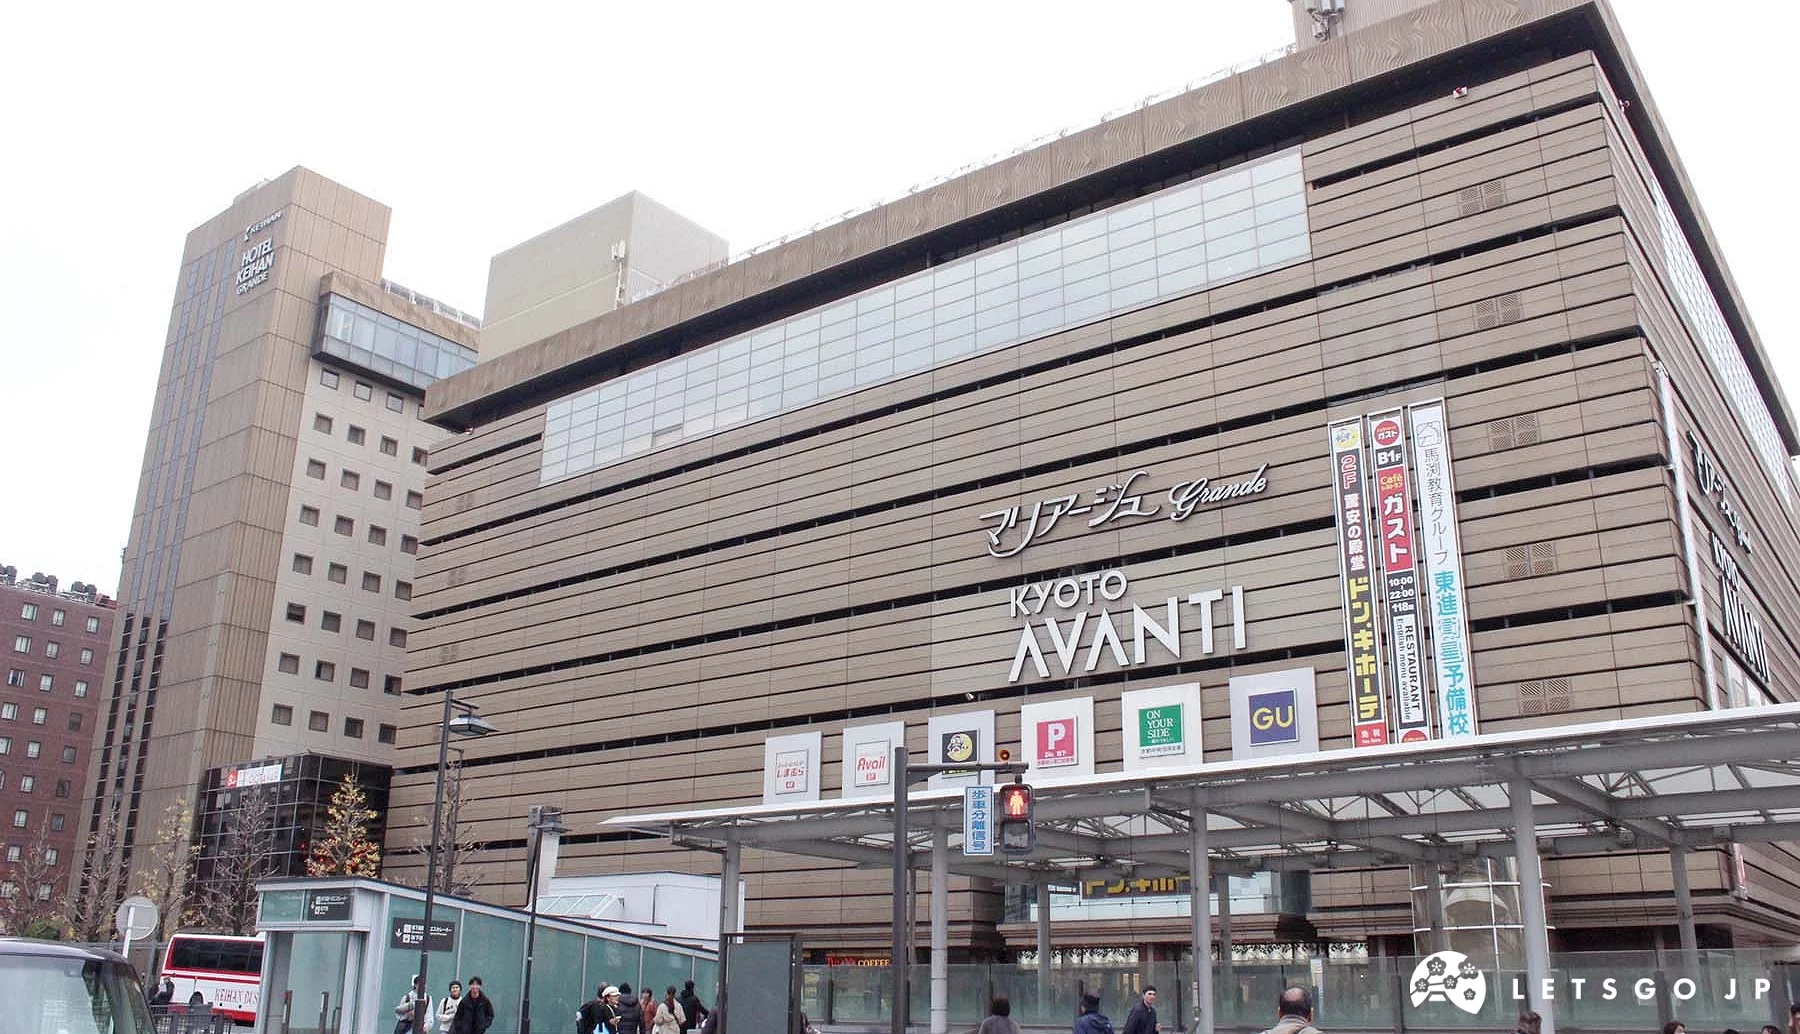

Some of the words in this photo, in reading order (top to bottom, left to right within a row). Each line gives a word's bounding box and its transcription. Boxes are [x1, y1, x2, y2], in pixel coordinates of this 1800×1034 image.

[241, 237, 273, 267] HOTEL
[235, 252, 275, 286] KEIHAN
[236, 271, 269, 295] GRANDE
[1377, 449, 1401, 465] B1F
[1341, 453, 1358, 490] 2F
[978, 470, 1160, 558] マリアージュ
[1168, 462, 1269, 522] Grande
[1384, 492, 1408, 564] ガスト
[1010, 569, 1128, 618] KYOTO
[1388, 575, 1413, 587] 10:00
[1389, 588, 1415, 600] 22:00
[1008, 584, 1247, 683] AVANTI
[1348, 576, 1379, 719] ドン・キホーテ
[1404, 625, 1421, 710] RESTAURANT
[1146, 709, 1161, 720] ON
[1146, 717, 1174, 729] YOUR
[1252, 704, 1294, 731] GU
[1047, 722, 1066, 751] P
[1147, 727, 1171, 739] SIDE
[857, 755, 886, 771] Avail
[971, 789, 986, 851] 歩車分離信号
[857, 958, 890, 967] COFFEE
[215, 988, 242, 1004] KEIHAN
